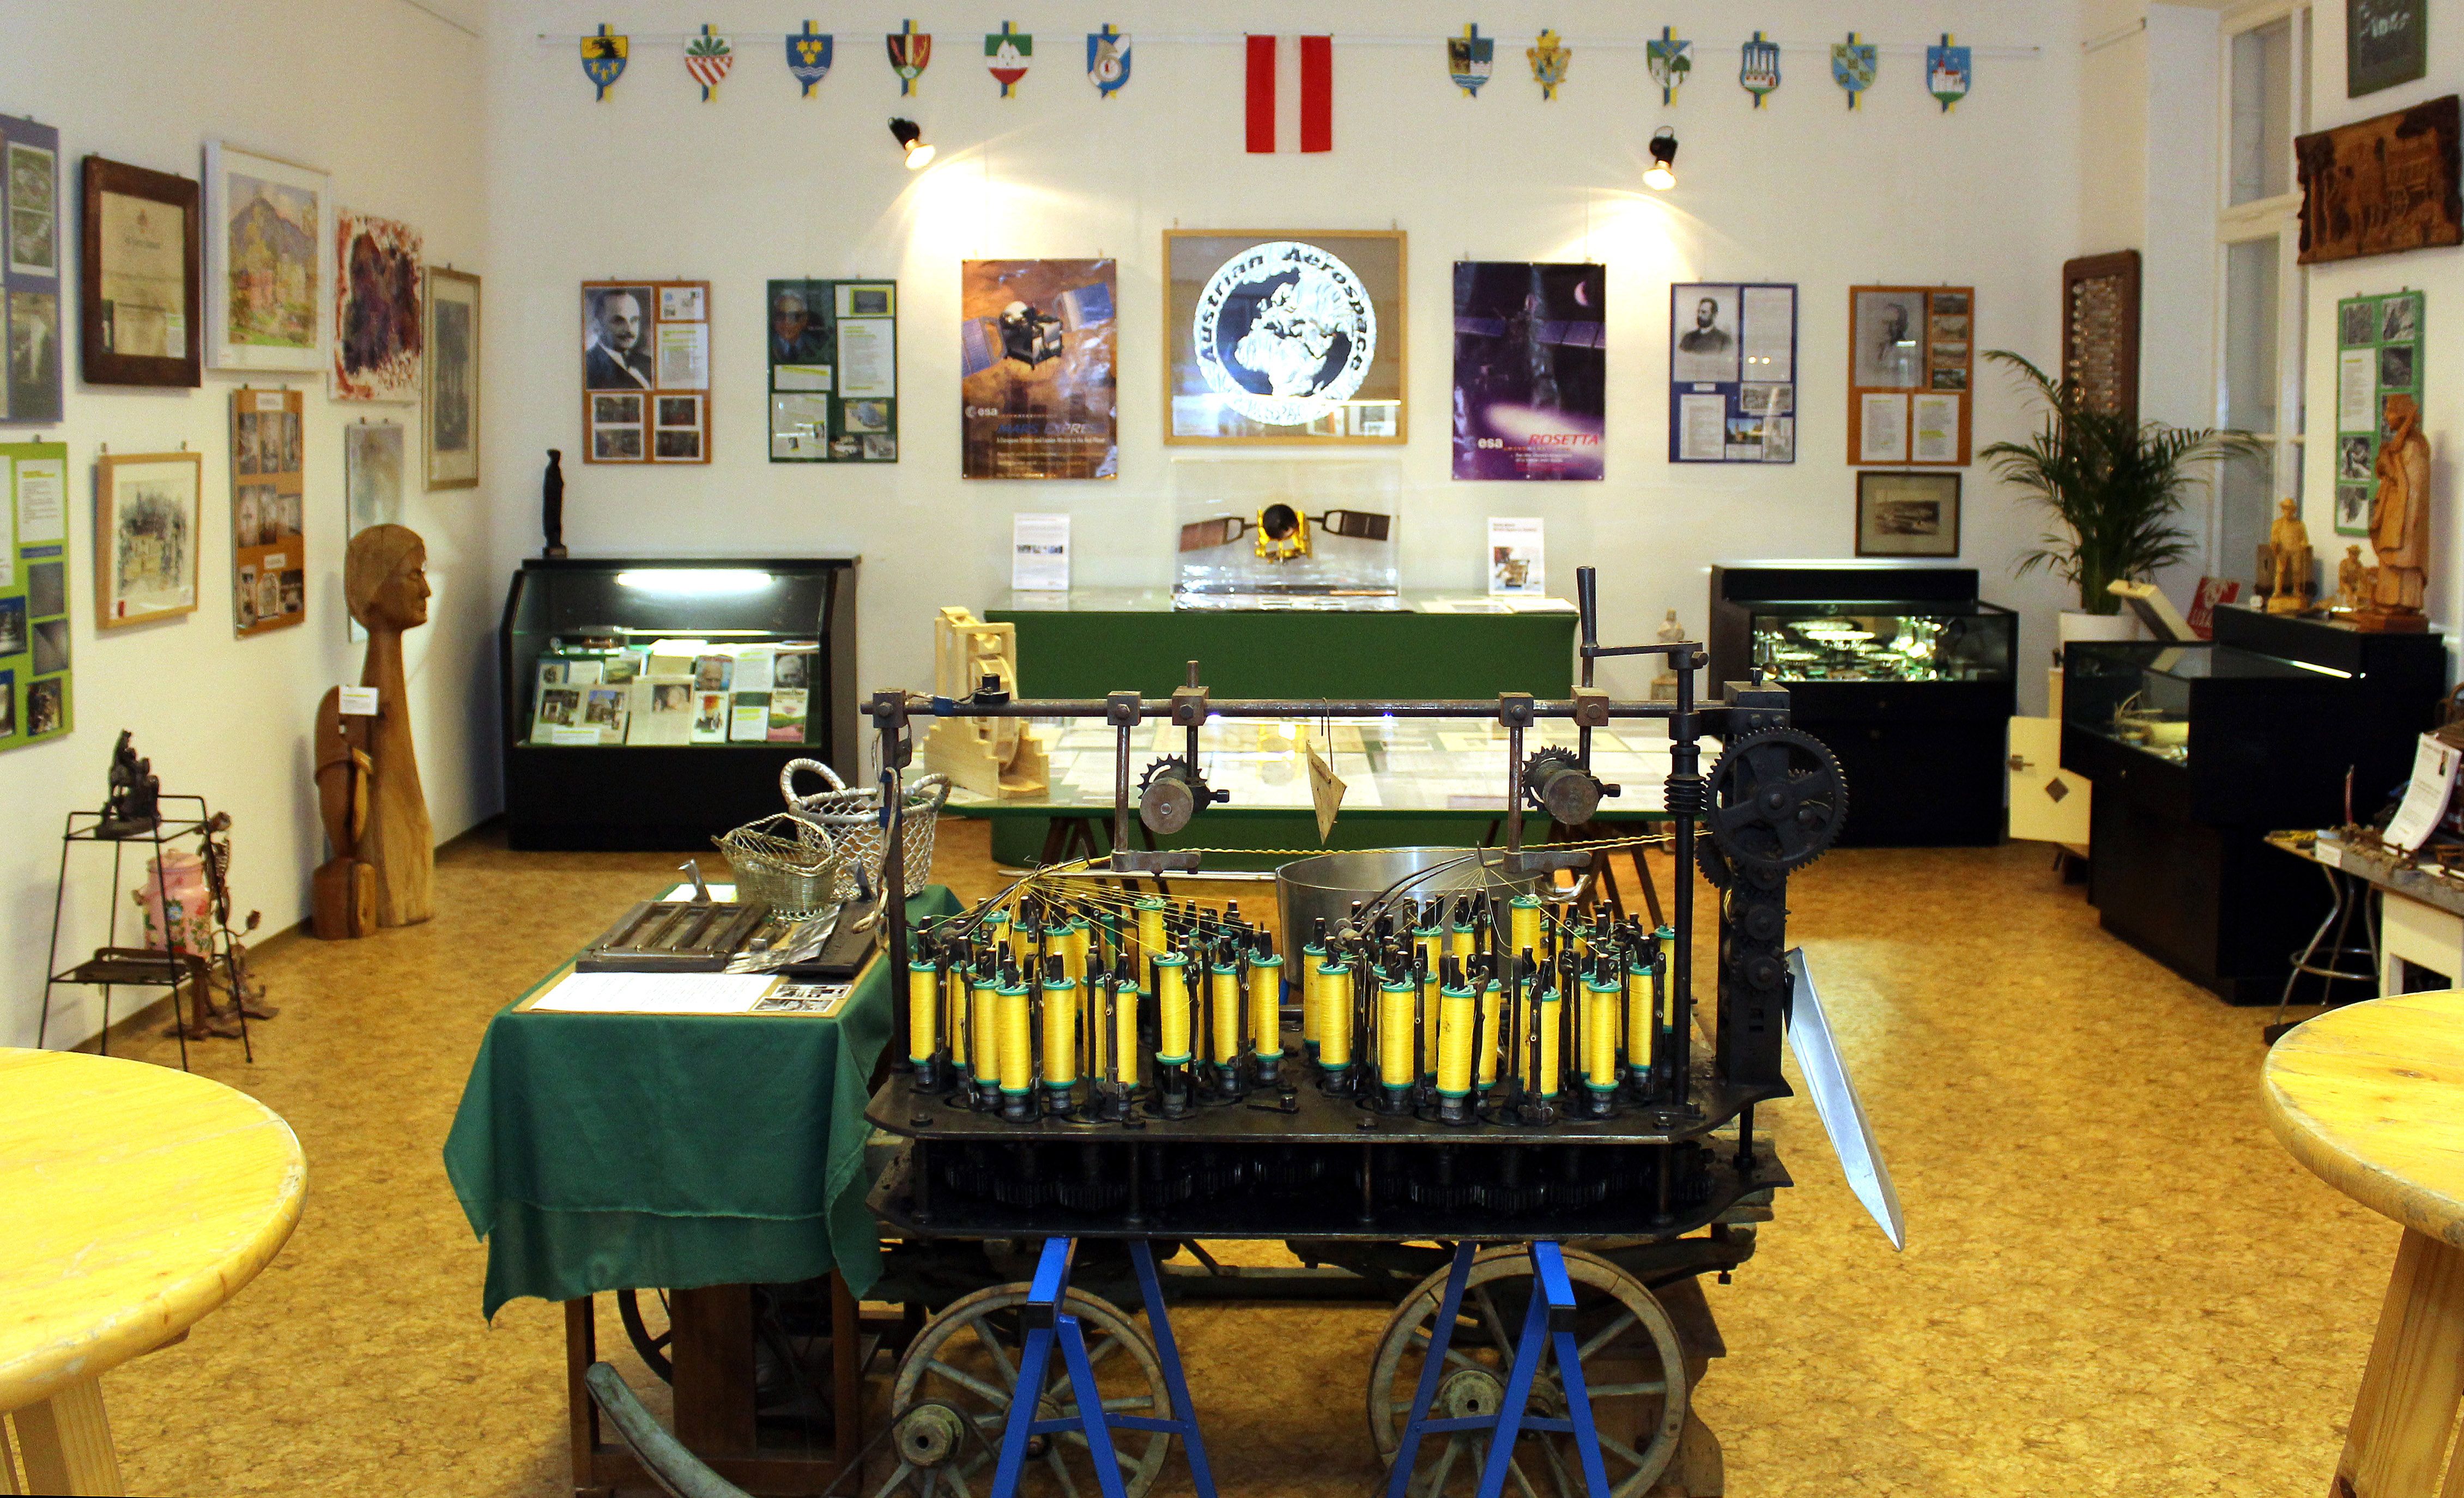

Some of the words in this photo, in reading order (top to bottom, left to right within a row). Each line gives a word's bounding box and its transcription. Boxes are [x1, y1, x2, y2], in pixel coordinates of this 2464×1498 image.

[1201, 254, 1264, 362] Austrian
[1282, 247, 1367, 371] Aerospace
[1478, 438, 1504, 449] esa
[1529, 434, 1599, 445] ROSETTA
